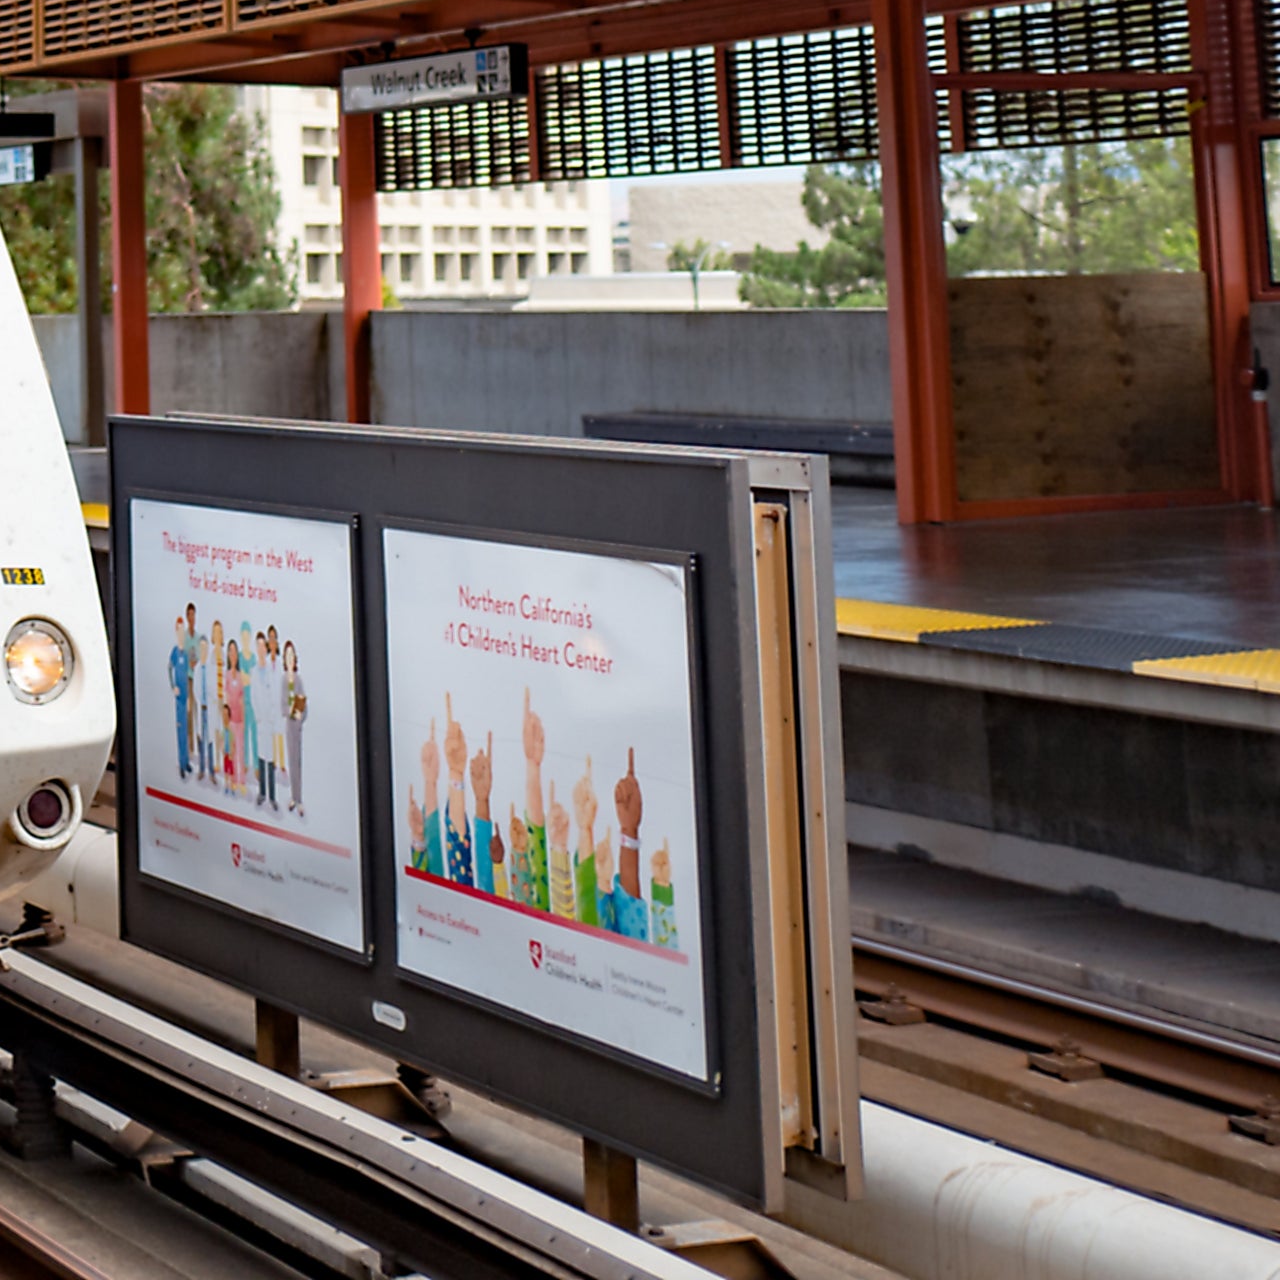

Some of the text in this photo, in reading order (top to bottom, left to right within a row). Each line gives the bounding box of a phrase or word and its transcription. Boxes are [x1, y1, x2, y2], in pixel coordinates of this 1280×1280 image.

[370, 61, 467, 96] Walnut Creek
[162, 531, 313, 573] The biggest program in the West
[2, 567, 44, 585] 1238
[189, 569, 278, 603] for kid-sized brains
[458, 584, 593, 629] Northern California's
[457, 622, 517, 657] Children's
[521, 633, 559, 665] Heart
[564, 641, 613, 674] Center
